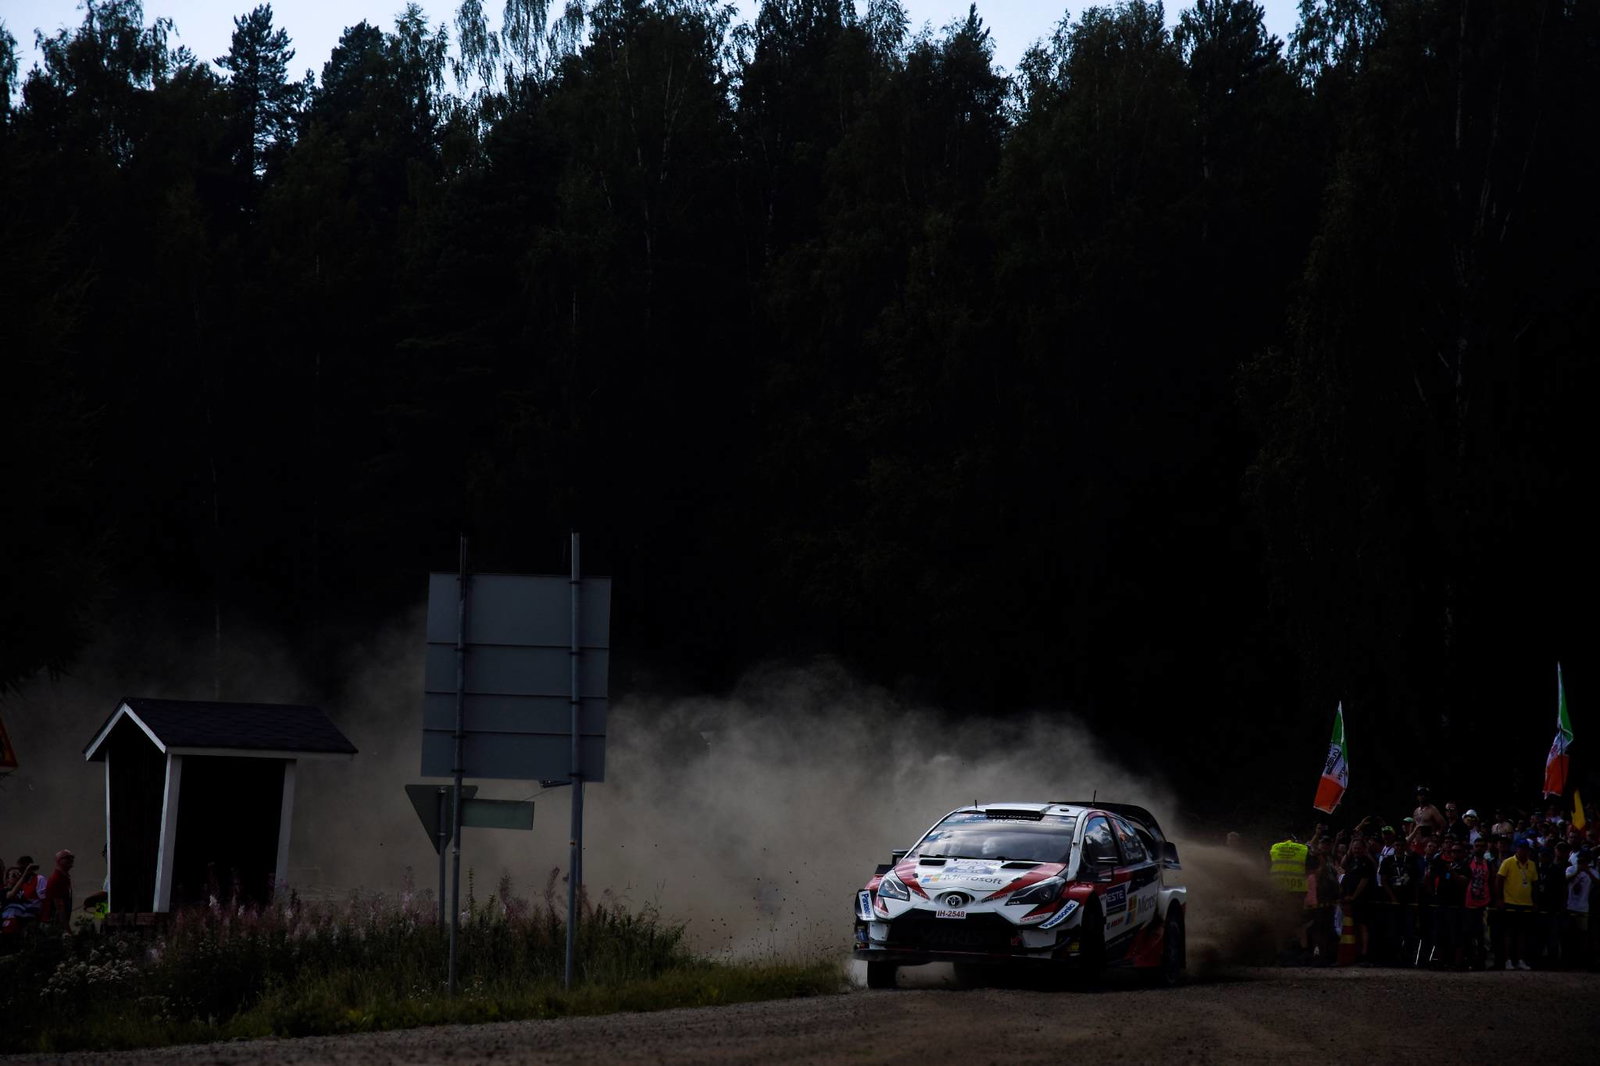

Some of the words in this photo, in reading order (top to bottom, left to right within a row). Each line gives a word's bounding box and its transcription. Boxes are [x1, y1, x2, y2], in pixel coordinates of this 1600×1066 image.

[943, 873, 1003, 885] Microsoft
[937, 910, 965, 918] IH-2548
[1042, 903, 1076, 927] Panasonic
